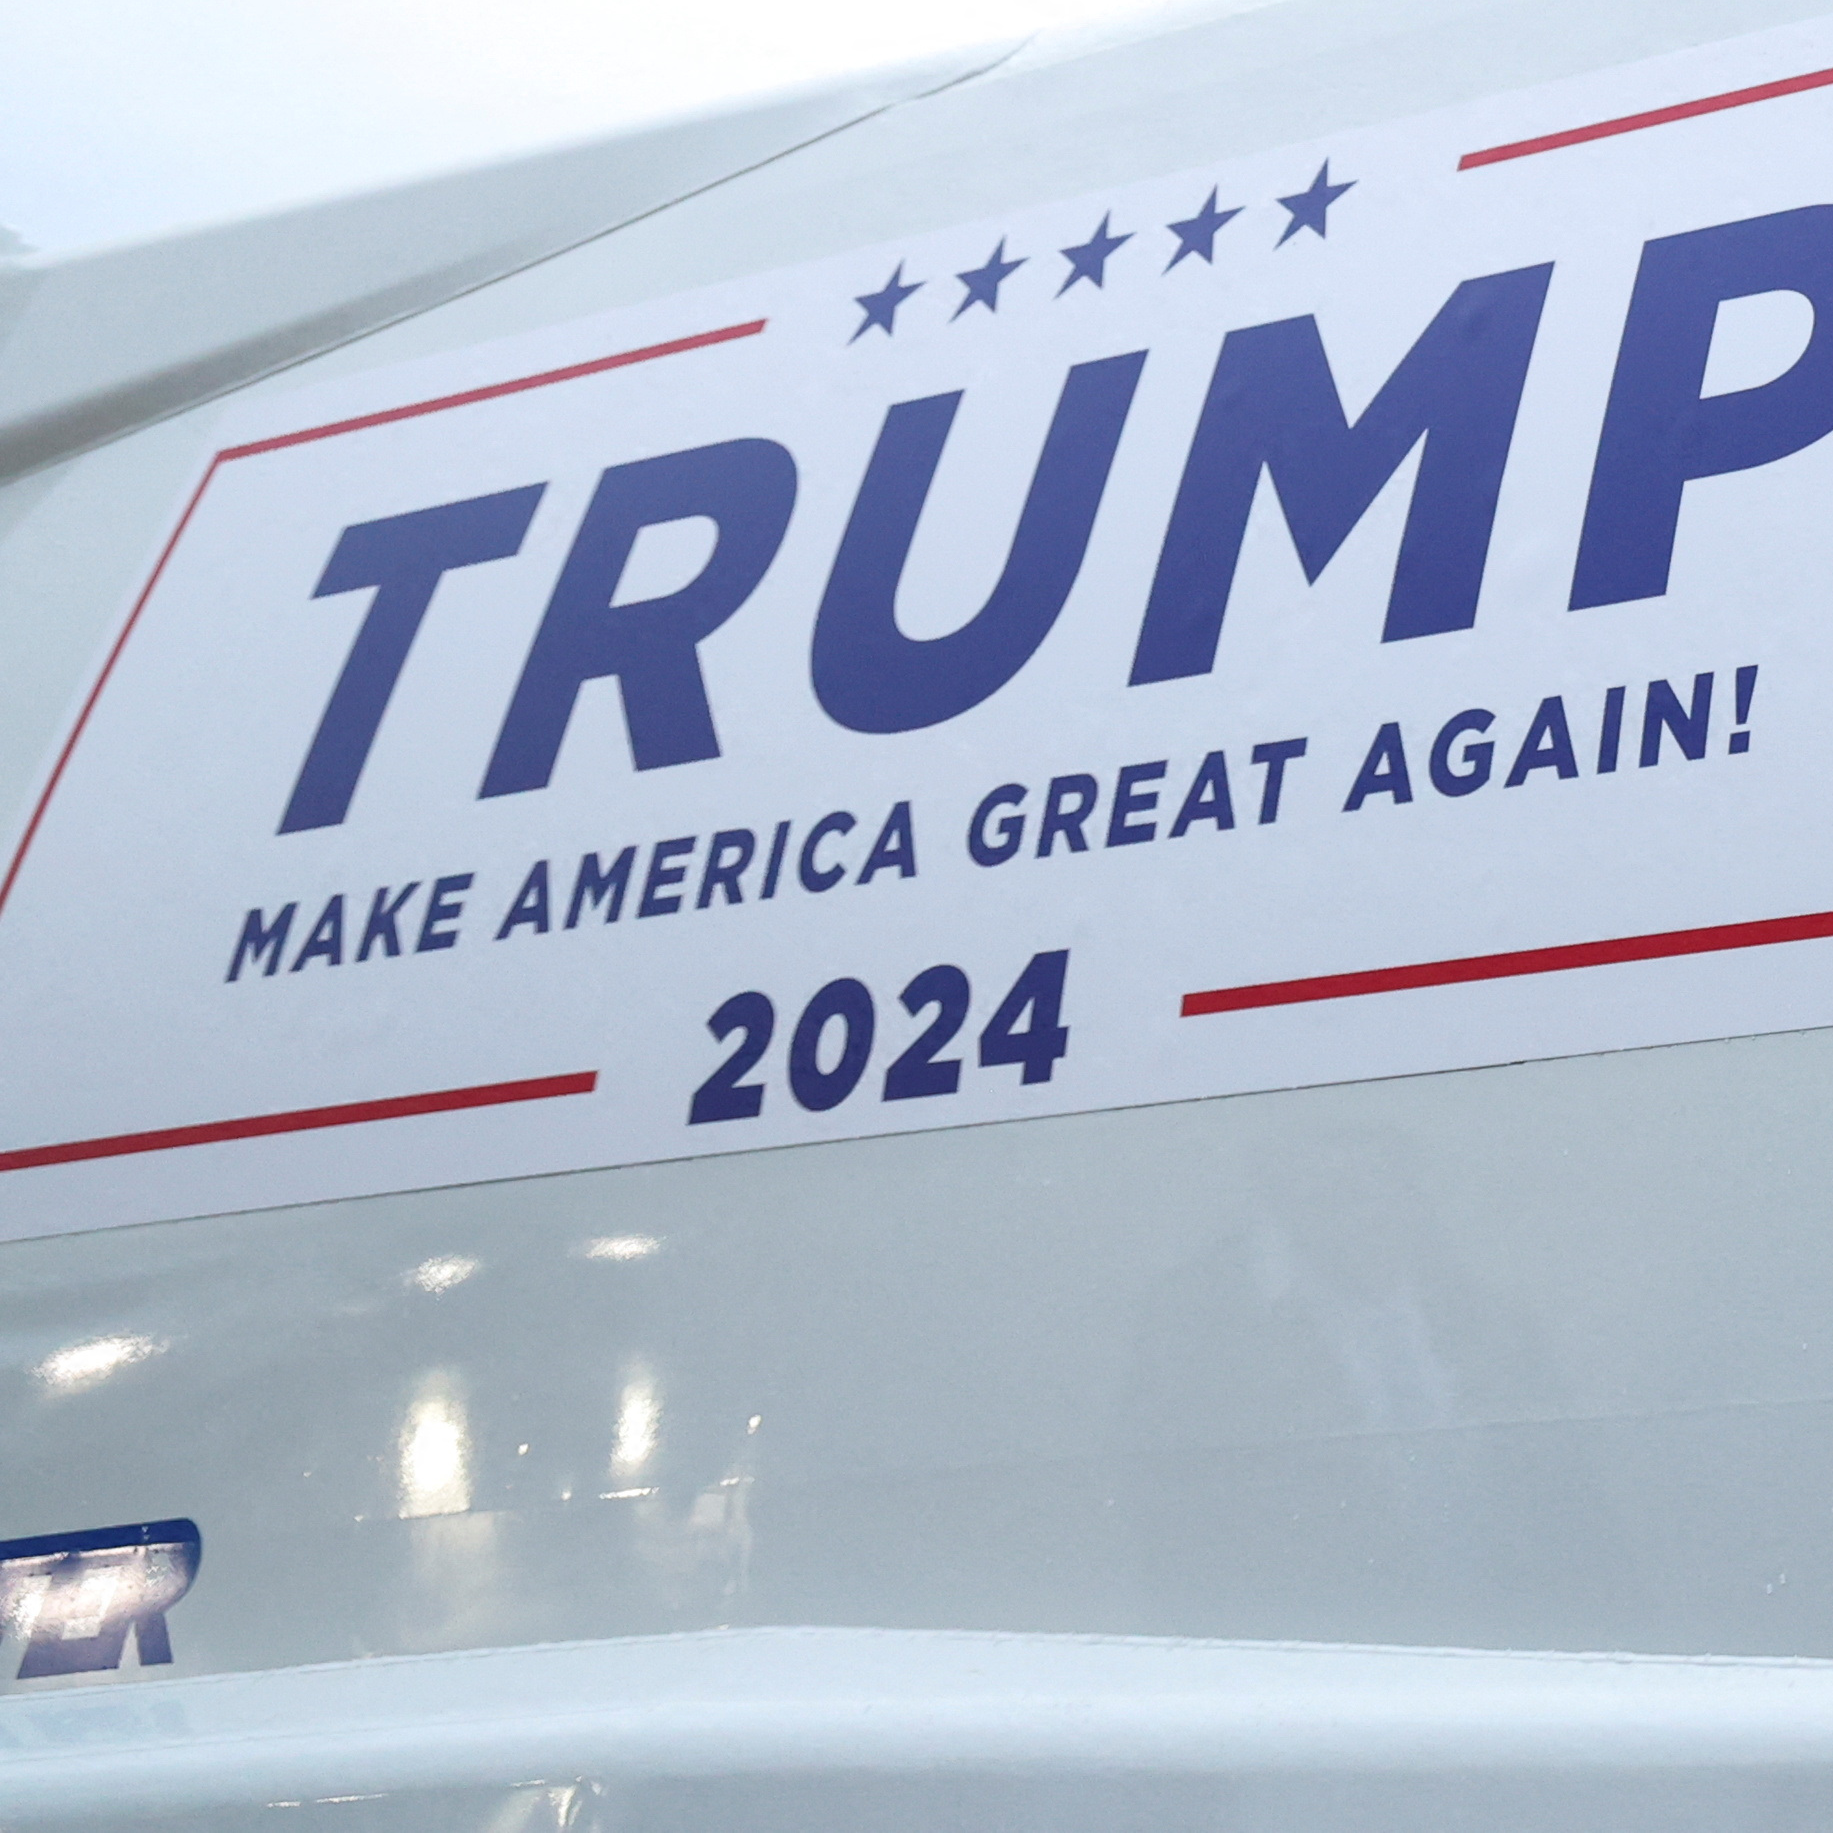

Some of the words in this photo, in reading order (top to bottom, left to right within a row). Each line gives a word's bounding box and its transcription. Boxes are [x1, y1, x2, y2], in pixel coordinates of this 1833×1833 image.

[224, 872, 475, 983] MAKE
[493, 801, 917, 941] AMERICA
[967, 736, 1308, 868] GREAT
[1342, 664, 1759, 812] AGAIN!
[685, 948, 1070, 1126] 2024
